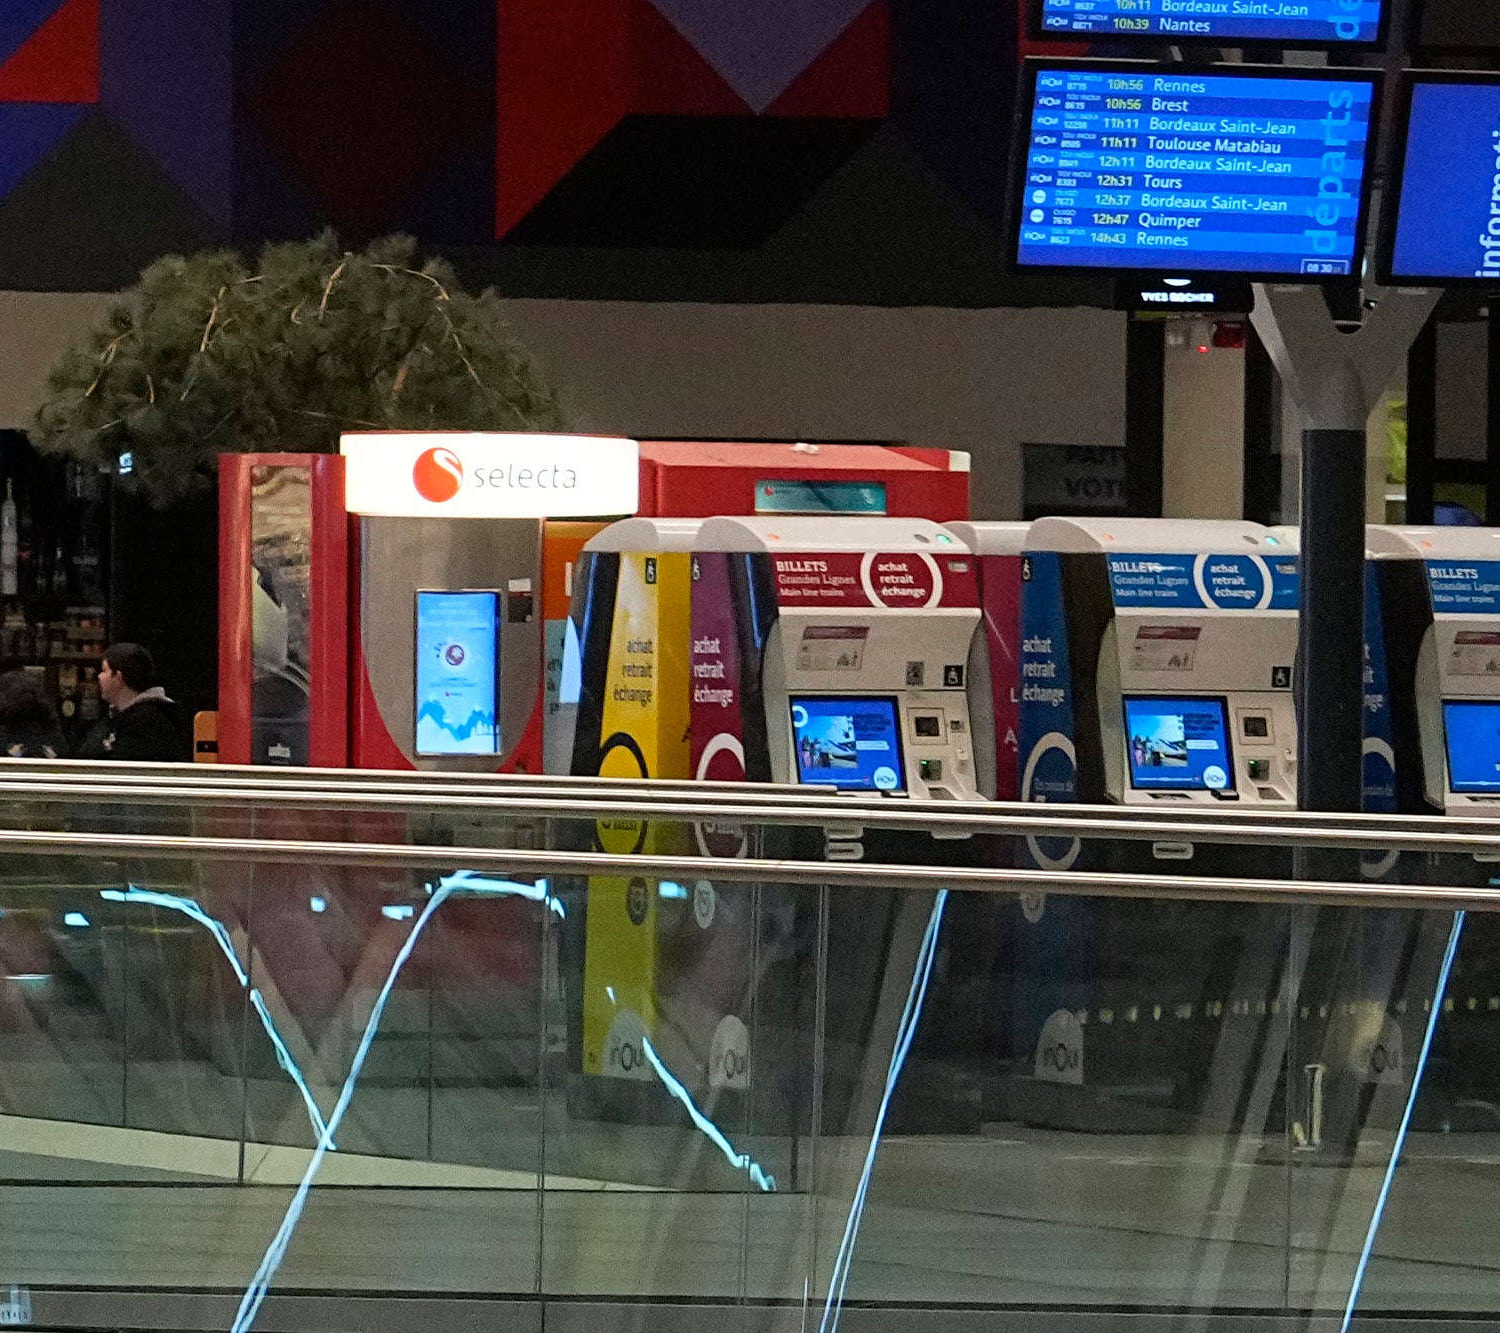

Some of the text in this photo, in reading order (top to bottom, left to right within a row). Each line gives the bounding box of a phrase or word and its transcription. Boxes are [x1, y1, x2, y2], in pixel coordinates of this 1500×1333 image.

[1161, 0, 1229, 15] Bordeaux
[1232, 1, 1309, 17] Saint-Jean
[1113, 18, 1150, 30] 10h39
[1159, 18, 1211, 33] Nantes
[1107, 78, 1206, 93] 10h56 Rennes
[1105, 98, 1142, 110] 10h56
[1151, 98, 1189, 112] Brest
[1103, 117, 1140, 129] 11h11
[1150, 117, 1216, 133] Bordeaux
[1219, 119, 1297, 135] Saint-Jean
[1101, 137, 1138, 148] 11h11
[1148, 136, 1212, 151] Toulouse
[1214, 138, 1282, 154] Matabiau
[1099, 156, 1136, 168] 12h11
[1145, 155, 1212, 171] Bordeaux
[1216, 158, 1292, 173] Saint-Jean
[1304, 89, 1355, 254] départs
[1097, 175, 1133, 187] 12h31
[1143, 174, 1183, 189] Tours
[1095, 194, 1131, 206] 12h37
[1141, 194, 1207, 209] Bordeaux
[1211, 196, 1288, 211] Saint-Jean
[1092, 214, 1129, 225] 12h47
[1138, 212, 1202, 229] Quimper
[1091, 231, 1189, 247] 14h43 Rennes
[474, 463, 577, 489] selecta
[776, 560, 828, 573] BILLETS
[877, 562, 909, 573] achat
[1210, 564, 1239, 574] achat
[1429, 568, 1479, 580] BILLETS
[778, 574, 856, 587] Grandes Lignes
[879, 573, 914, 584] retrait
[1114, 575, 1154, 585] Grandes
[1211, 576, 1246, 586] retrait
[1432, 581, 1472, 591] Grandes
[780, 588, 801, 597] Main
[821, 588, 845, 598] trains
[880, 585, 926, 598] échange
[1115, 588, 1137, 597] Main
[1153, 589, 1178, 598] trains
[1214, 587, 1257, 599] échange
[1433, 594, 1454, 602] Main
[627, 637, 653, 655] achat
[693, 636, 721, 655] achat
[1022, 635, 1052, 653] achat
[622, 662, 653, 680] retrait
[693, 661, 725, 679] retrait
[1022, 660, 1056, 678] retrait
[613, 685, 653, 708] échange
[693, 685, 734, 708] échange
[1022, 685, 1065, 707] échange
